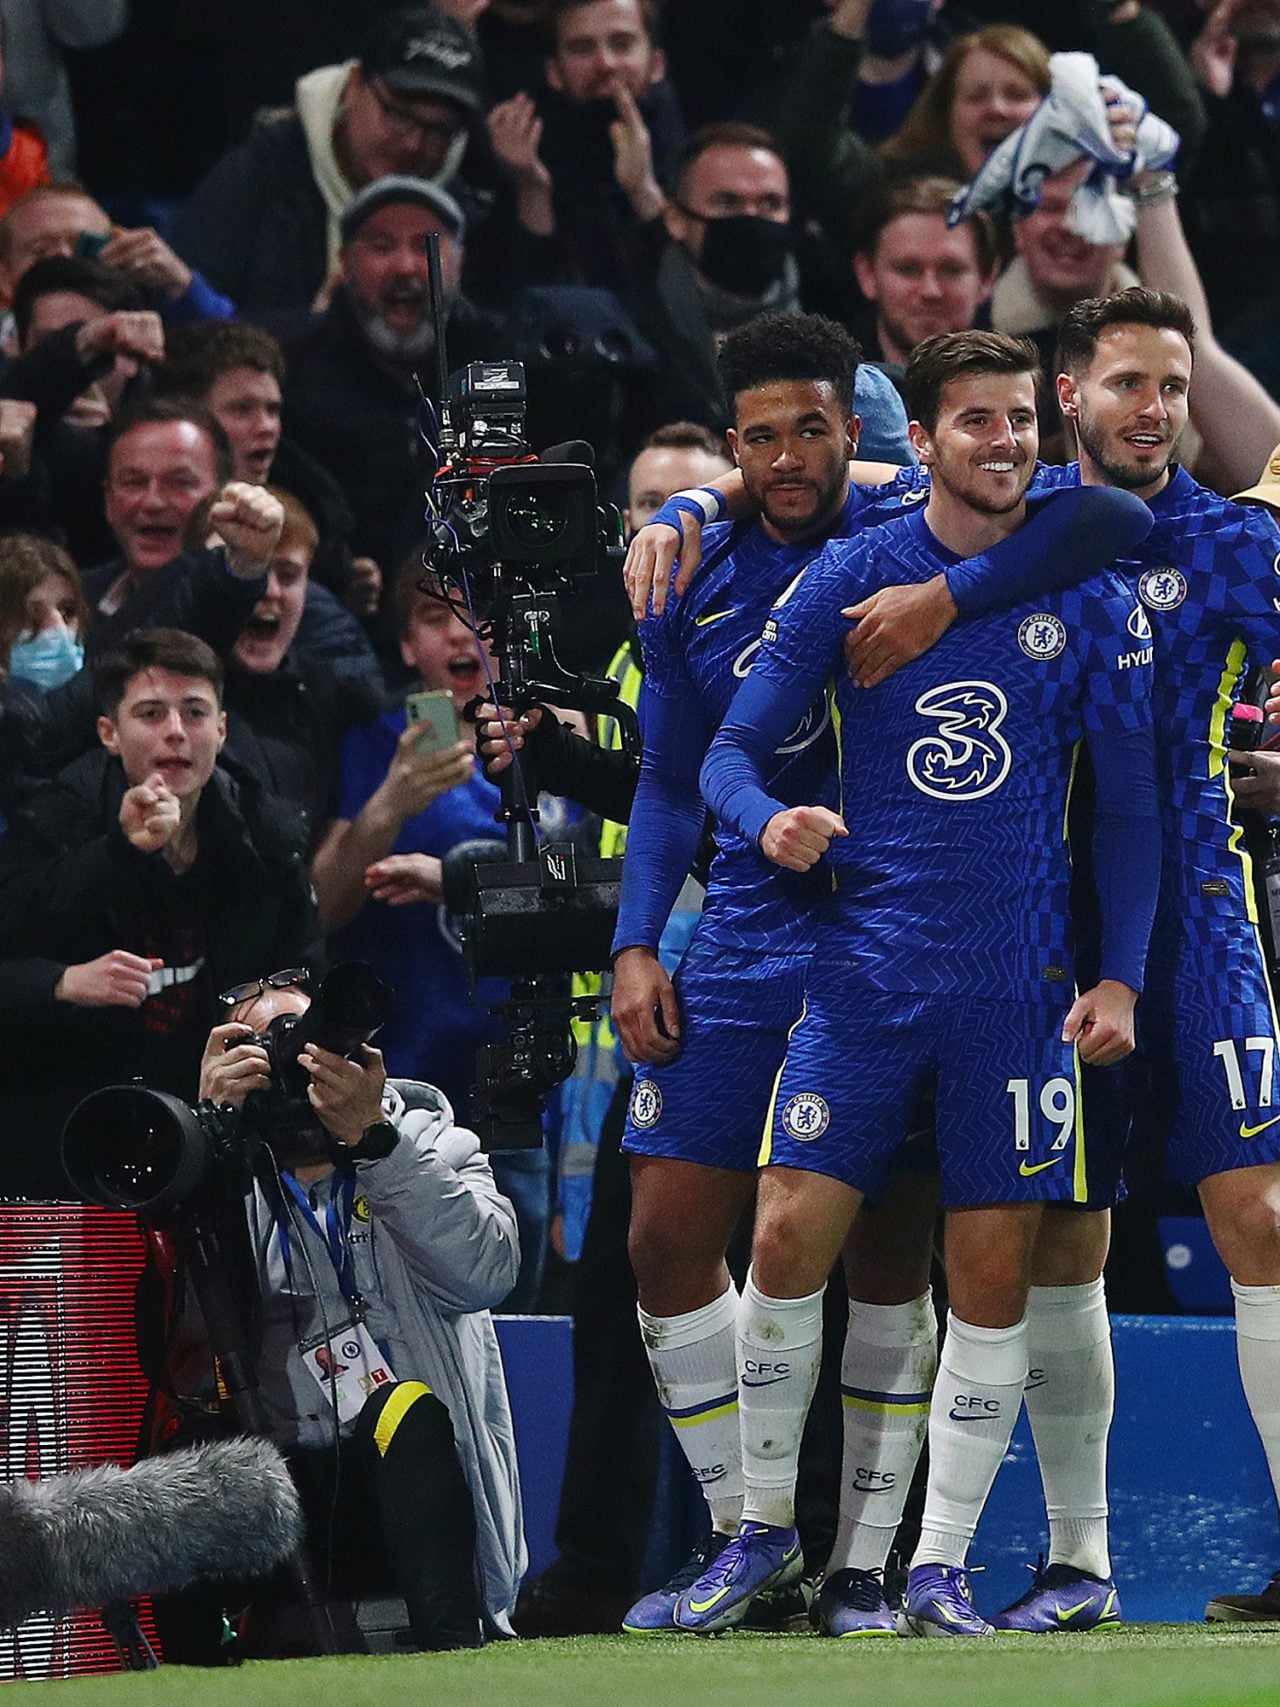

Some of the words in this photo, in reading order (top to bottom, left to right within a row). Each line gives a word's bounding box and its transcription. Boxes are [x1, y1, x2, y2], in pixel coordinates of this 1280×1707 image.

[906, 681, 1012, 801] 3
[1213, 1037, 1275, 1111] 17
[1006, 1077, 1075, 1151] 19
[744, 1359, 790, 1375] CFC
[954, 1394, 1000, 1412] CFC
[690, 1463, 726, 1478] CFC
[855, 1467, 896, 1483] CFC
